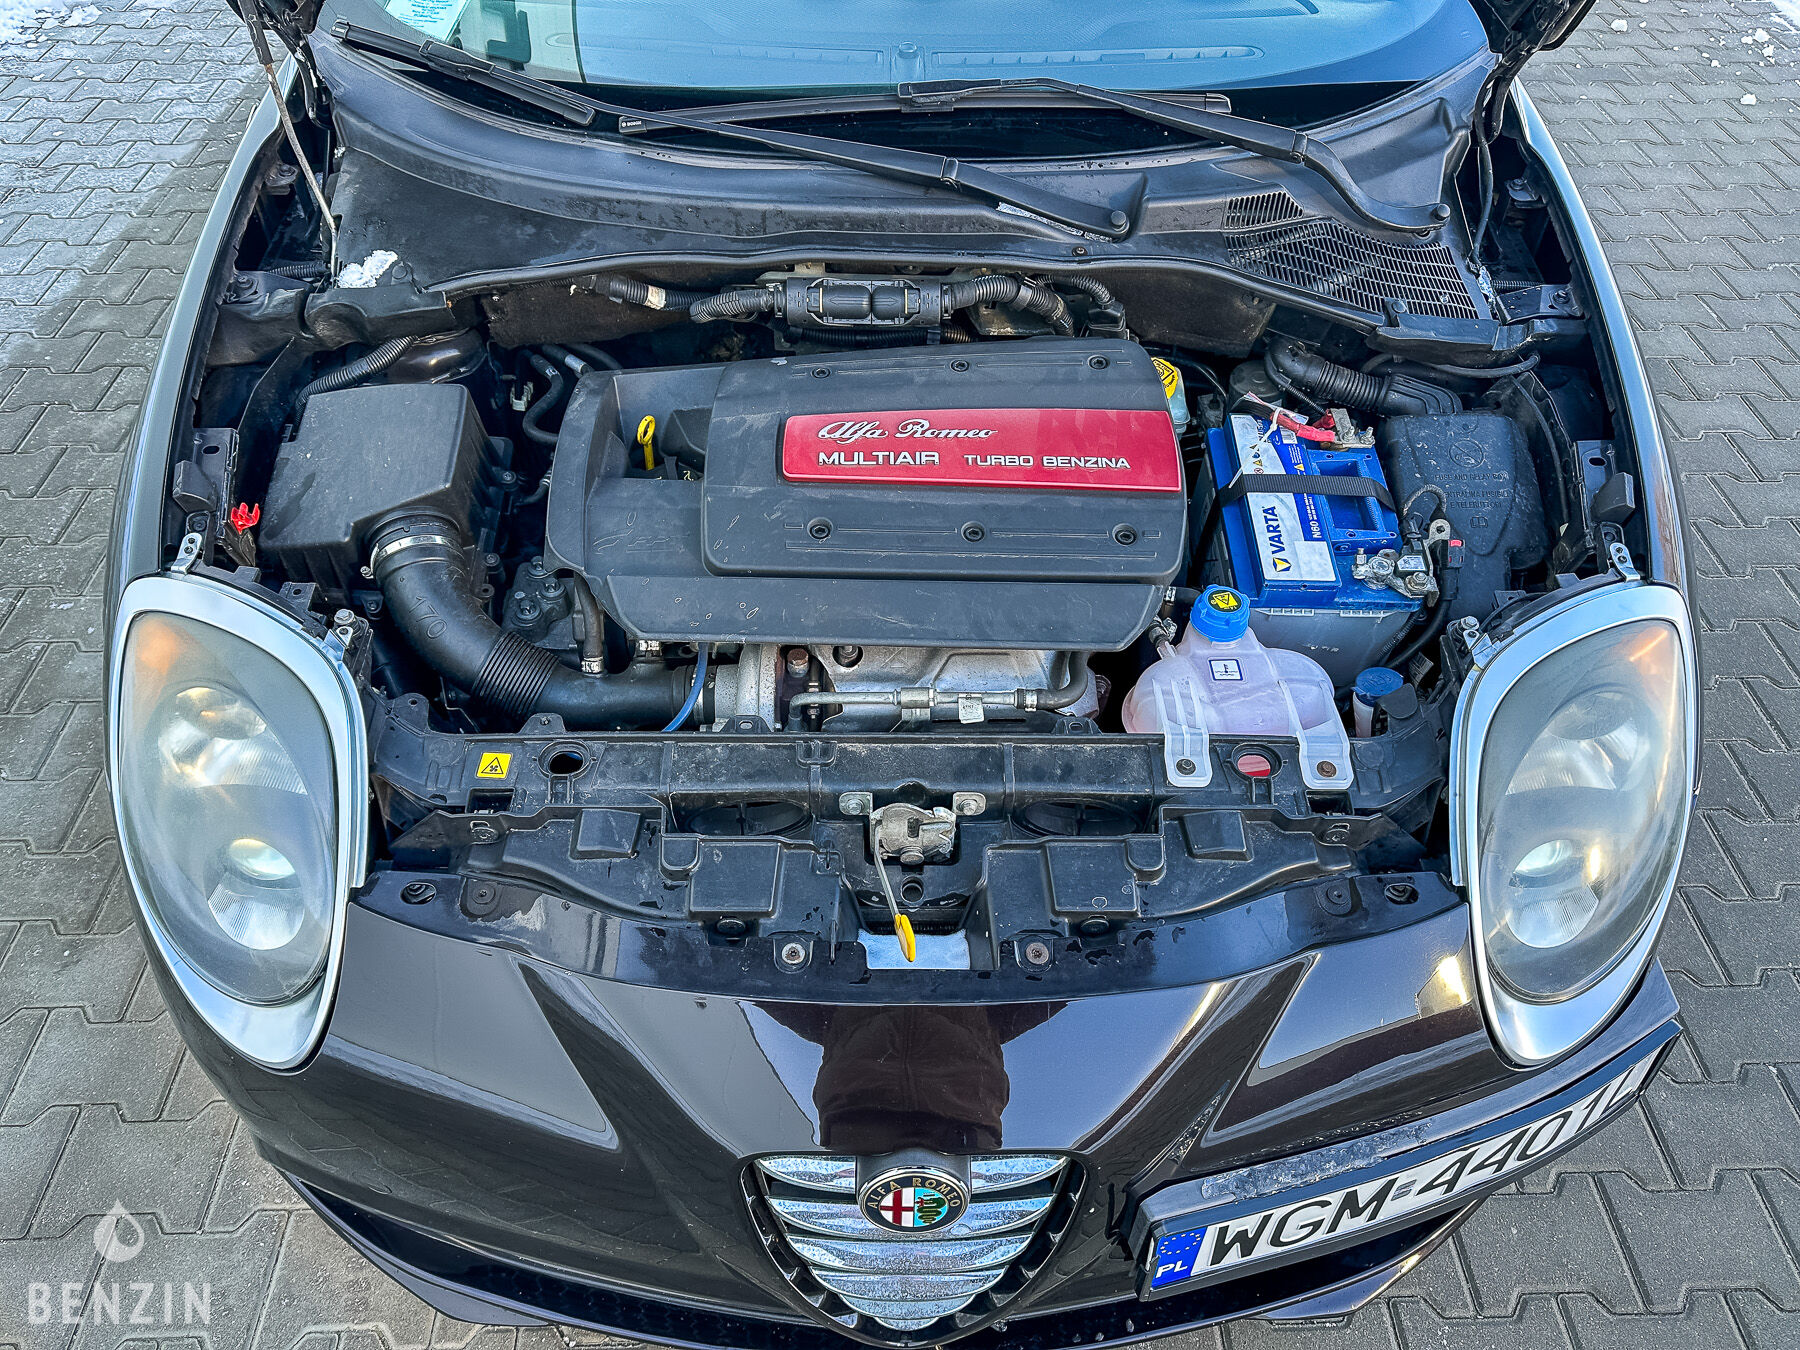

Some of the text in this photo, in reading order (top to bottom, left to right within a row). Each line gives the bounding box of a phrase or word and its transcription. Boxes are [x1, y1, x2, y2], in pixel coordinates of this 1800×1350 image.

[818, 418, 998, 444] Alfa Romeo
[818, 450, 1131, 470] MULTIAIR TURBO BENZINA
[1263, 506, 1286, 554] VARTA
[1309, 520, 1322, 539] N60
[867, 1178, 961, 1209] ALFA ROMEO
[1210, 1176, 1400, 1266] WGM
[1155, 1260, 1188, 1279] PL
